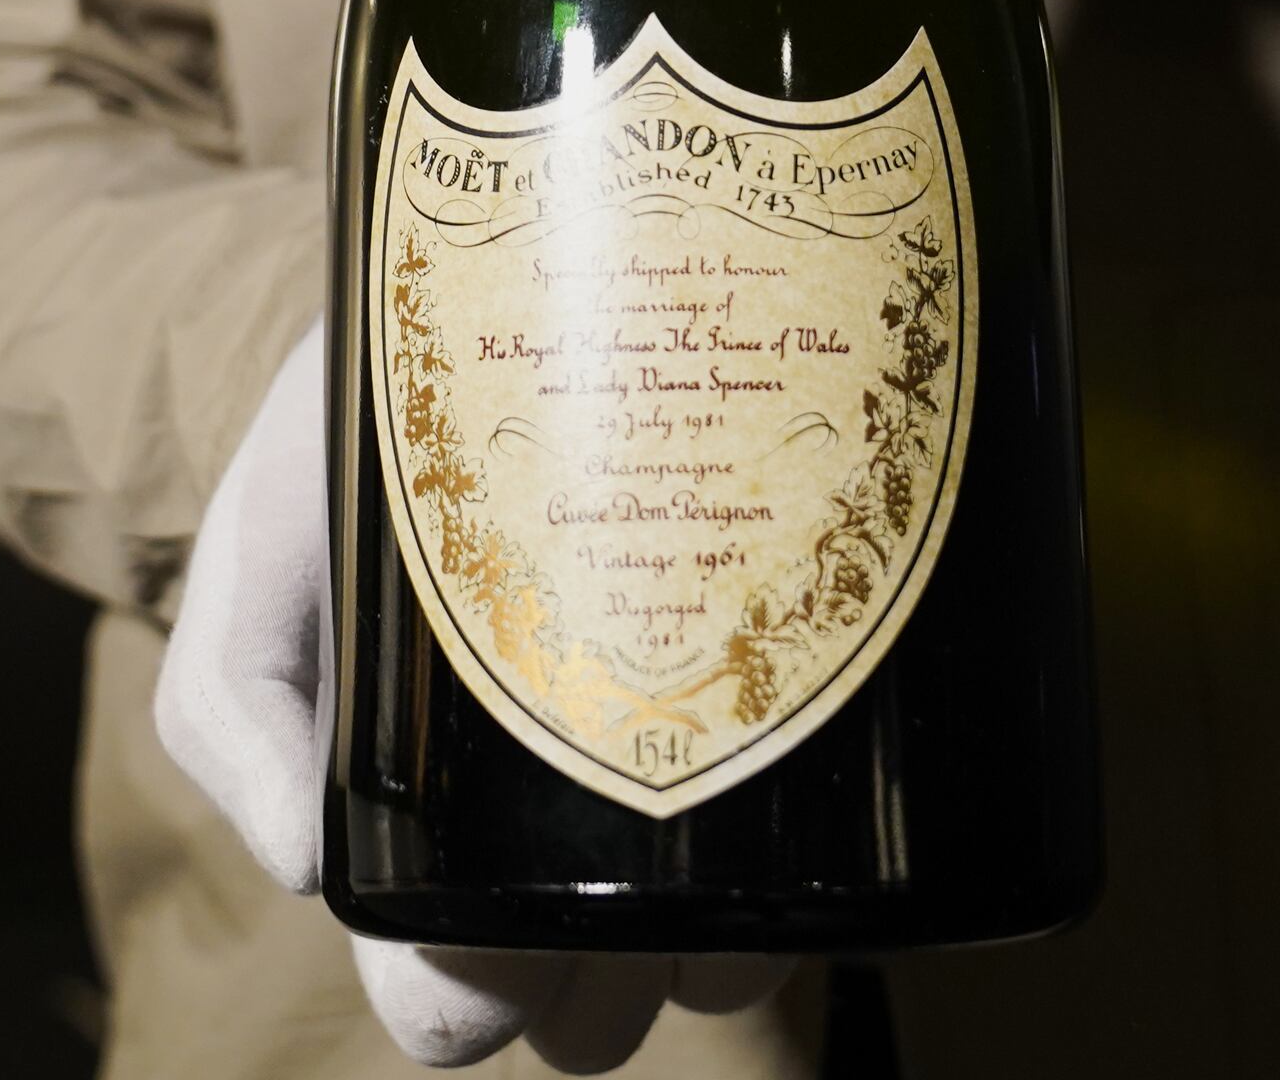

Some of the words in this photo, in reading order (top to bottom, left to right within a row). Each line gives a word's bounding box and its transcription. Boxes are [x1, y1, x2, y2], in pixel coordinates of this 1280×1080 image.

[410, 137, 509, 193] MOËT
[514, 169, 535, 192] et
[542, 118, 752, 183] CANDON
[792, 140, 919, 195] Epernay
[536, 162, 712, 218] Eblished
[735, 184, 795, 215] 1743
[531, 256, 617, 290] Speclly
[622, 254, 692, 287] shipped
[699, 255, 717, 276] to
[723, 254, 790, 276] honour
[621, 296, 709, 325] marriage
[716, 291, 734, 320] of
[477, 335, 507, 360] His
[509, 332, 565, 369] Royal
[663, 327, 700, 353] The
[707, 325, 763, 353] Prince
[770, 328, 790, 360] of
[795, 327, 851, 354] Wales
[537, 372, 570, 397] and
[576, 369, 628, 403] Lady
[637, 367, 701, 394] Diana
[708, 366, 787, 402] Spencer
[596, 415, 617, 438] 29
[624, 405, 673, 440] July
[685, 413, 724, 440] 1981
[584, 454, 734, 484] Champagne
[547, 492, 609, 526] Cuvée
[612, 491, 671, 522] Dom
[671, 490, 775, 531] Pérignon
[577, 543, 677, 578] Vintage
[695, 542, 746, 581] 1961
[605, 591, 707, 631] Disgorged
